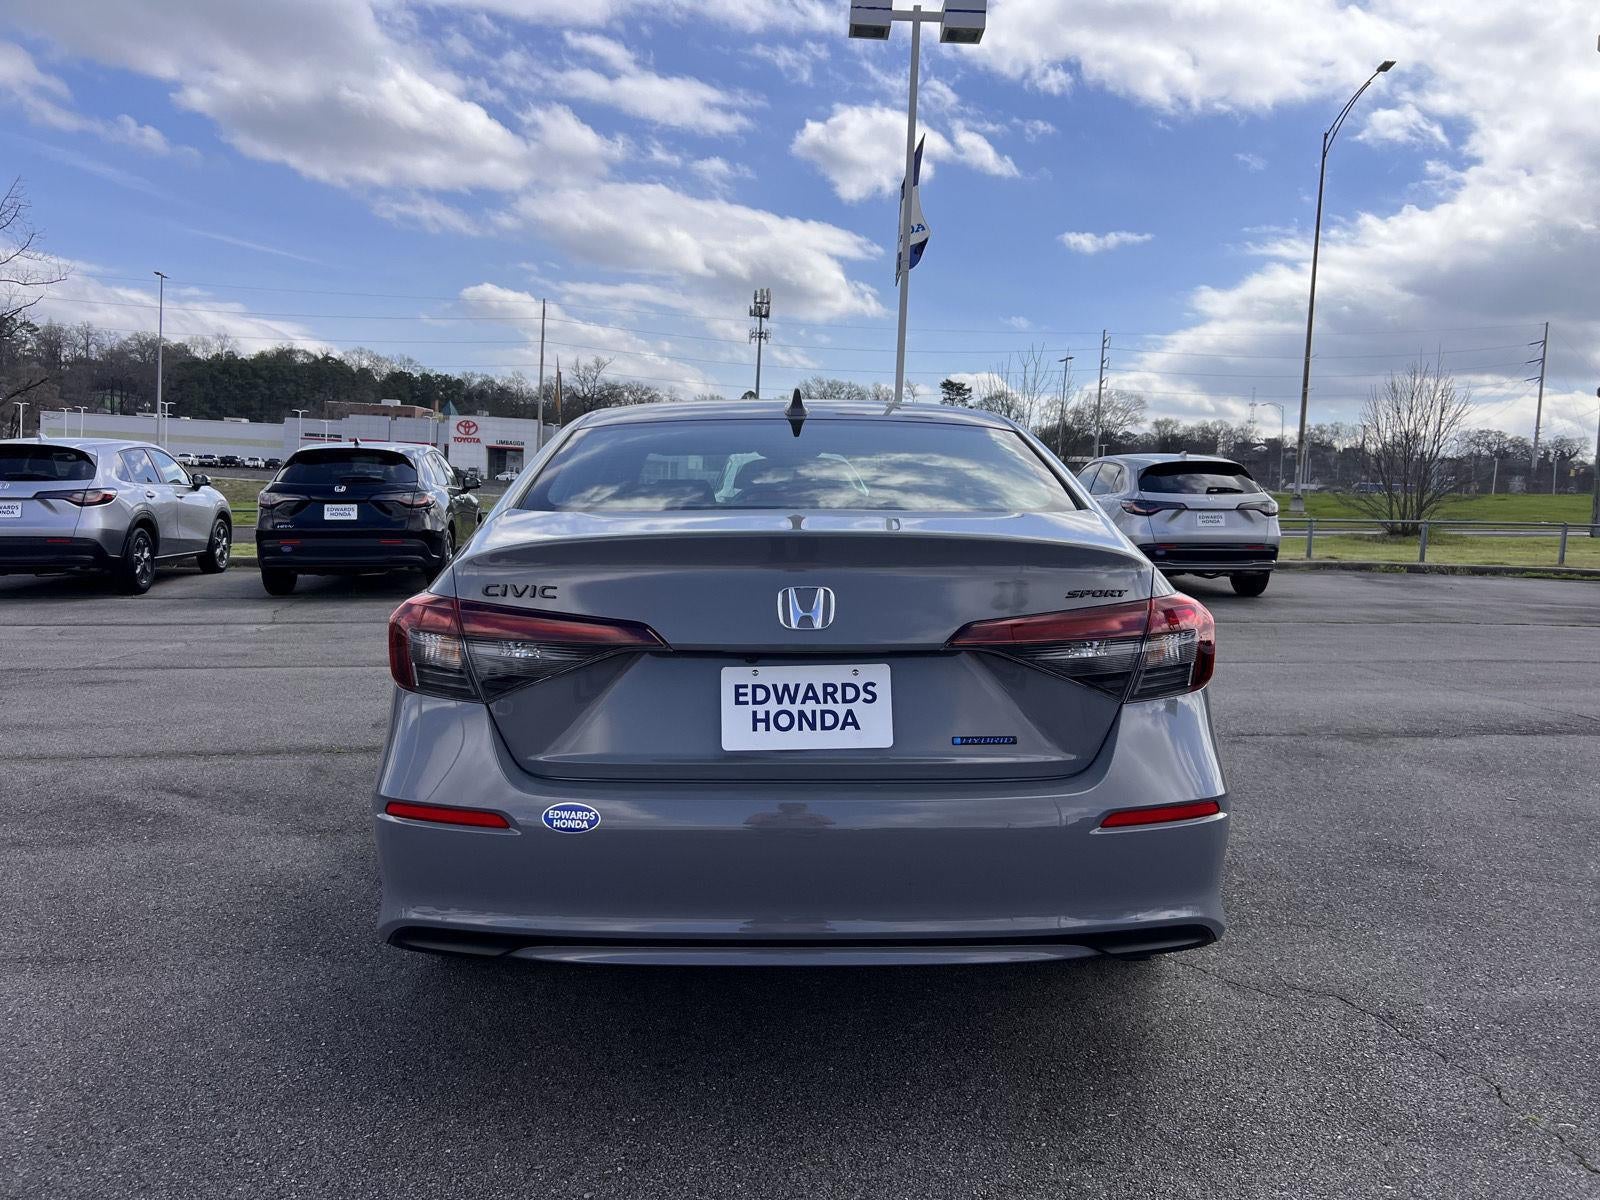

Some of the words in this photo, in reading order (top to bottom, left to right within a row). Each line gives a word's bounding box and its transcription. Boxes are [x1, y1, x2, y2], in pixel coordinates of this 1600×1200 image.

[482, 584, 558, 599] CIVIC
[1065, 589, 1128, 598] SPORT
[734, 682, 878, 706] EDWARDS
[751, 709, 861, 732] HONDA
[548, 810, 596, 820] EDWARDS
[553, 819, 589, 829] HONDA
